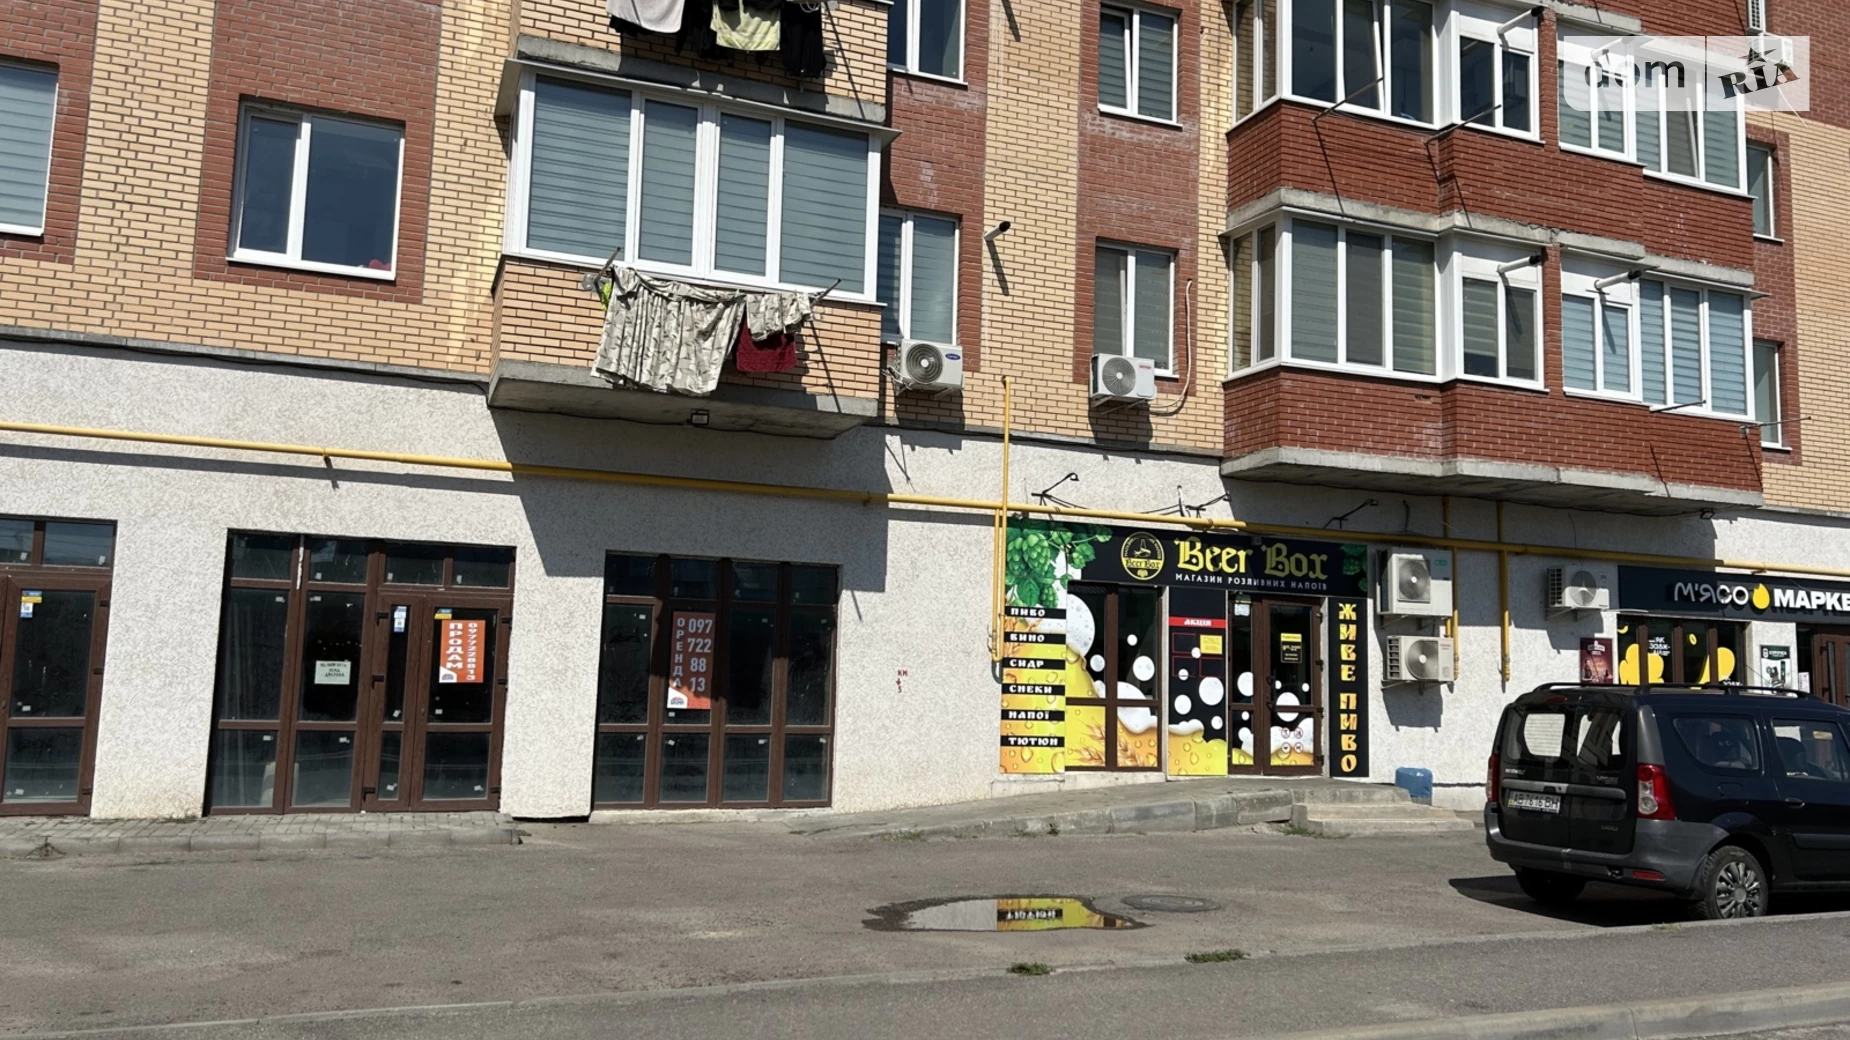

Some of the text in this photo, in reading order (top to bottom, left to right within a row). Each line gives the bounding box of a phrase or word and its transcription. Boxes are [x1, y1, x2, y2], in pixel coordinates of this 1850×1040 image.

[1173, 536, 1252, 573] Beer
[1261, 542, 1328, 579] Box
[1175, 572, 1328, 591] МАГАЗИН РОЗЛИВНИХ НАПОЇВ
[1674, 582, 1749, 605] М'ЯСО
[688, 619, 713, 634] 097
[446, 622, 464, 669] ПРОДАМ
[673, 618, 685, 687] ОРЕНДА
[687, 638, 711, 653] 722
[690, 658, 707, 673] 88
[1009, 659, 1044, 669] СИДР
[690, 678, 706, 692] 13
[1009, 685, 1053, 694] СНЕКИ
[1338, 602, 1357, 772] ЖИВЕ ПИВО
[1008, 711, 1050, 720] НАПОЇ
[1008, 737, 1059, 747] ТЮТЮН
